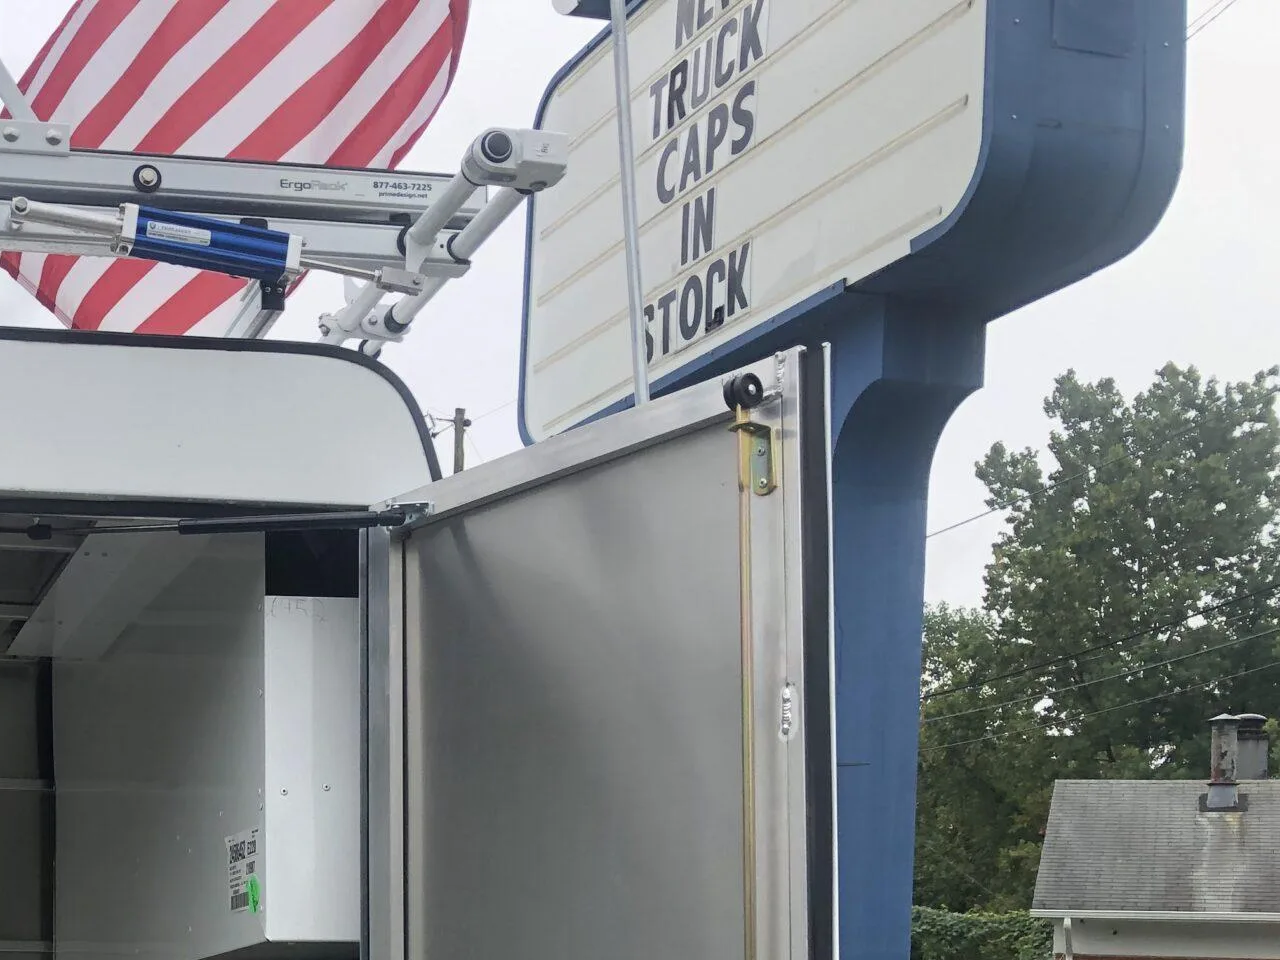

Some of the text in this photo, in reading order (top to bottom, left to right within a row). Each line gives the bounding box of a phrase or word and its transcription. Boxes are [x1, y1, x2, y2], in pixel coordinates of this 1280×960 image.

[650, 0, 764, 140] TRUCK
[373, 181, 433, 192] 877-463-7225
[656, 80, 756, 204] CAPS
[680, 187, 715, 266] IN
[643, 242, 751, 365] STOCK
